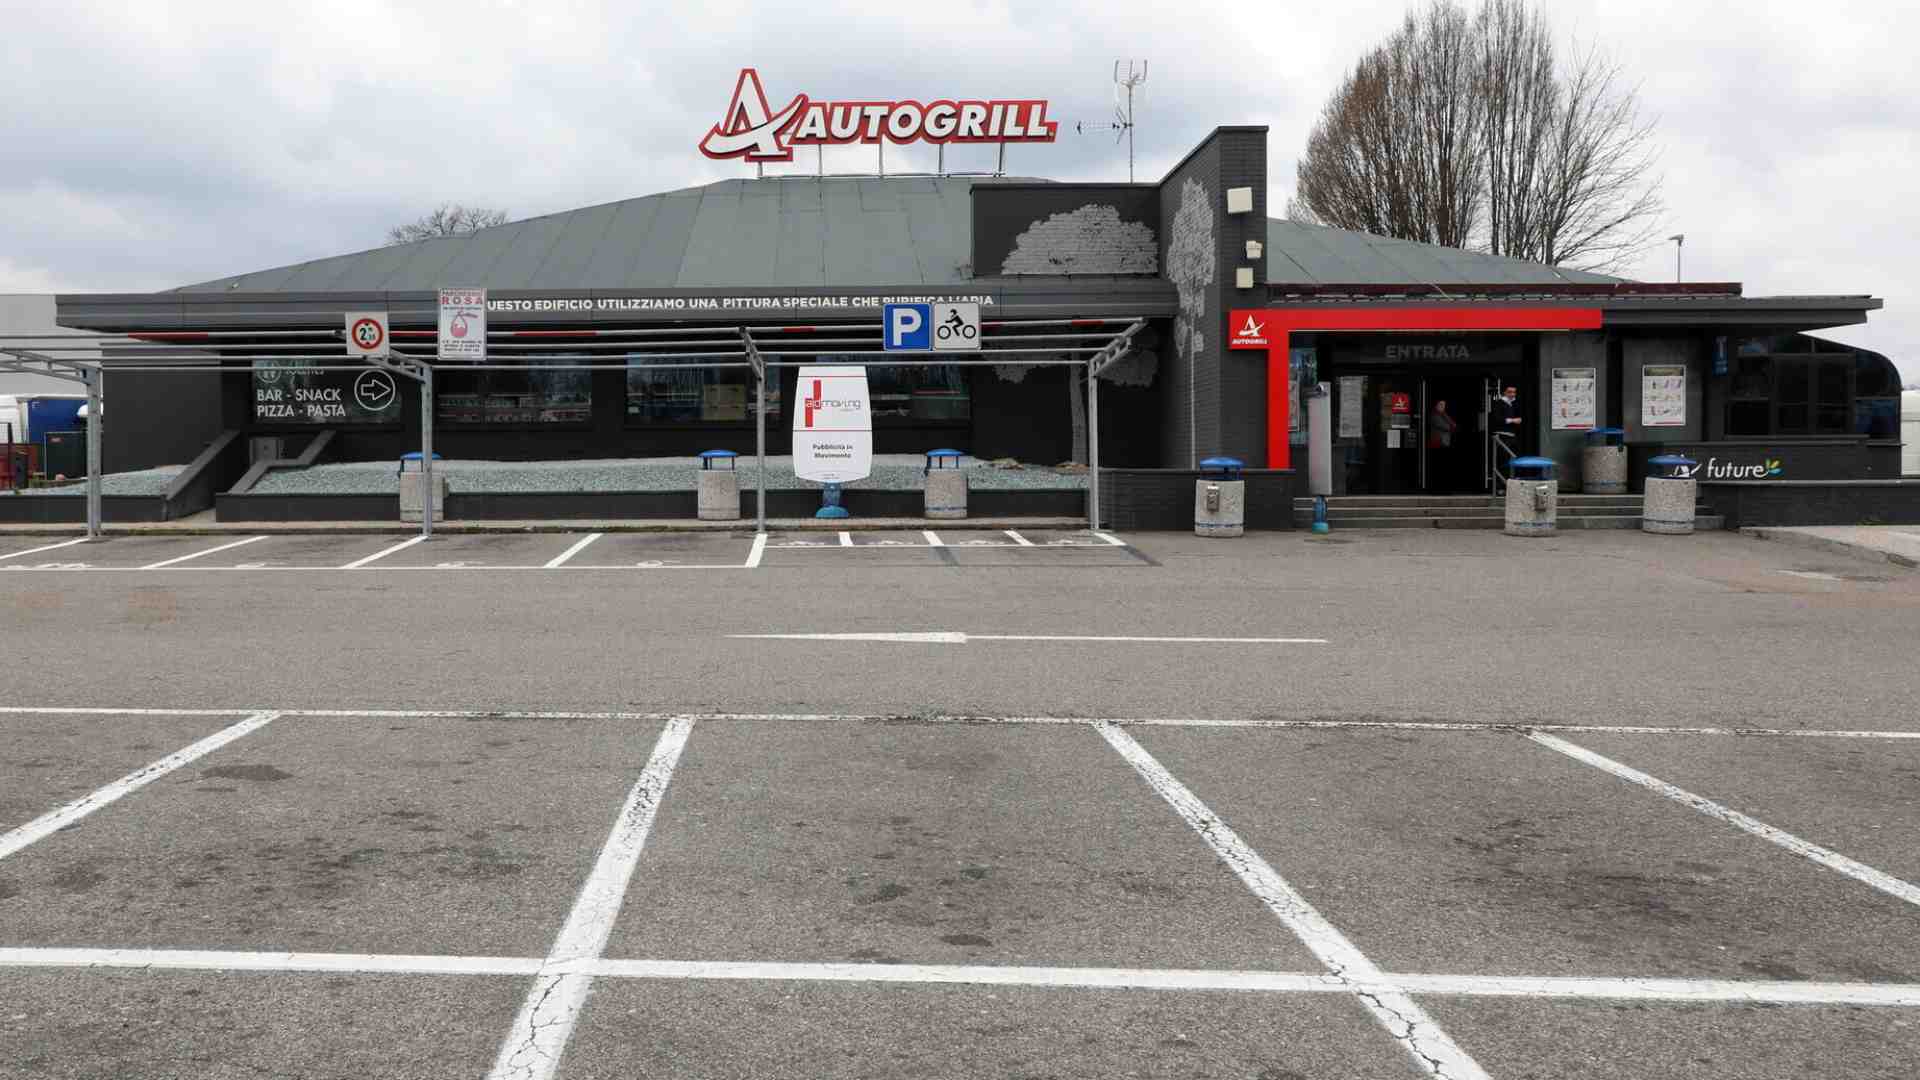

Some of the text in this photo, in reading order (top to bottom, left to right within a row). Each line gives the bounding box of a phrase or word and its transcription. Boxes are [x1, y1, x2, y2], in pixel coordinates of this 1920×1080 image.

[795, 103, 1051, 139] AUTOGRILL
[441, 295, 483, 305] ROSA
[486, 300, 532, 311] UESTO
[534, 299, 593, 311] EDIFICIO
[597, 298, 686, 310] UTILIZZIAMO
[688, 298, 719, 309] UNA
[722, 297, 780, 309] PITTURA
[782, 296, 849, 308] SPECIALE
[851, 296, 880, 307] CHE
[892, 308, 922, 346] P
[1385, 344, 1470, 360] ENTRATA
[257, 388, 283, 402] BAR
[295, 388, 342, 402] SNACK
[257, 404, 295, 418] PIZZA
[307, 404, 346, 418] PASTA
[1706, 457, 1769, 479] future
